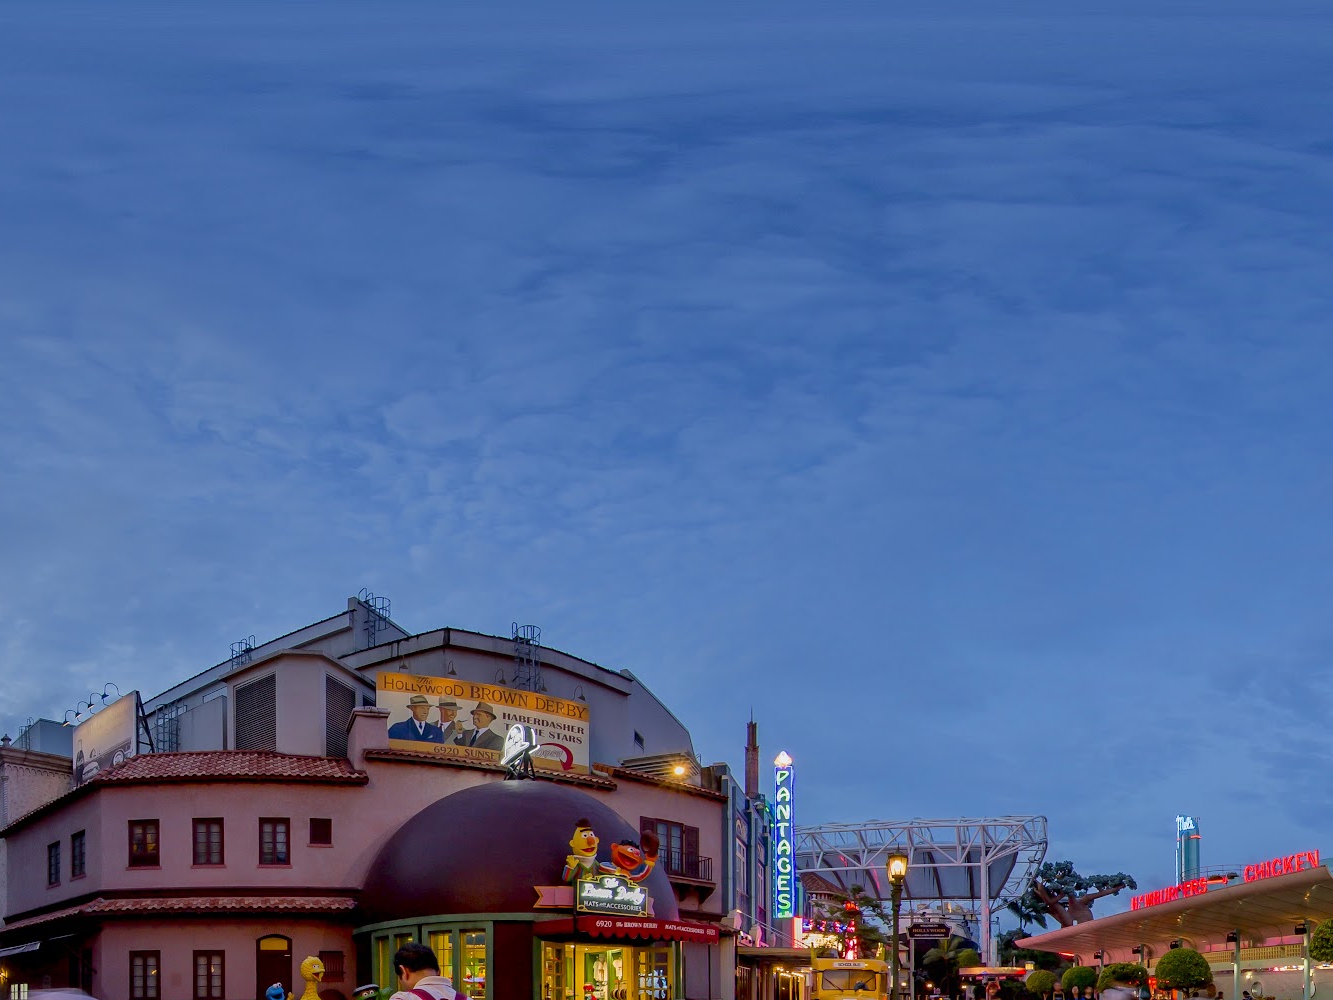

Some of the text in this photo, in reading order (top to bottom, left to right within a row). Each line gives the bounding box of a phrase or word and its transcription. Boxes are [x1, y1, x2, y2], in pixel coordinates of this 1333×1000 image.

[415, 676, 433, 685] The
[383, 675, 587, 719] HOLLYWOOD BROWN DERBY
[502, 712, 584, 735] HABERDASHER
[548, 731, 583, 745] STARS
[433, 746, 502, 761] 6920 SUNSET
[776, 770, 791, 910] PANTAGES
[1243, 849, 1320, 883] CHICKEN
[583, 900, 599, 908] HATS
[606, 902, 643, 912] ACCESSORIES
[595, 920, 613, 928] 6920
